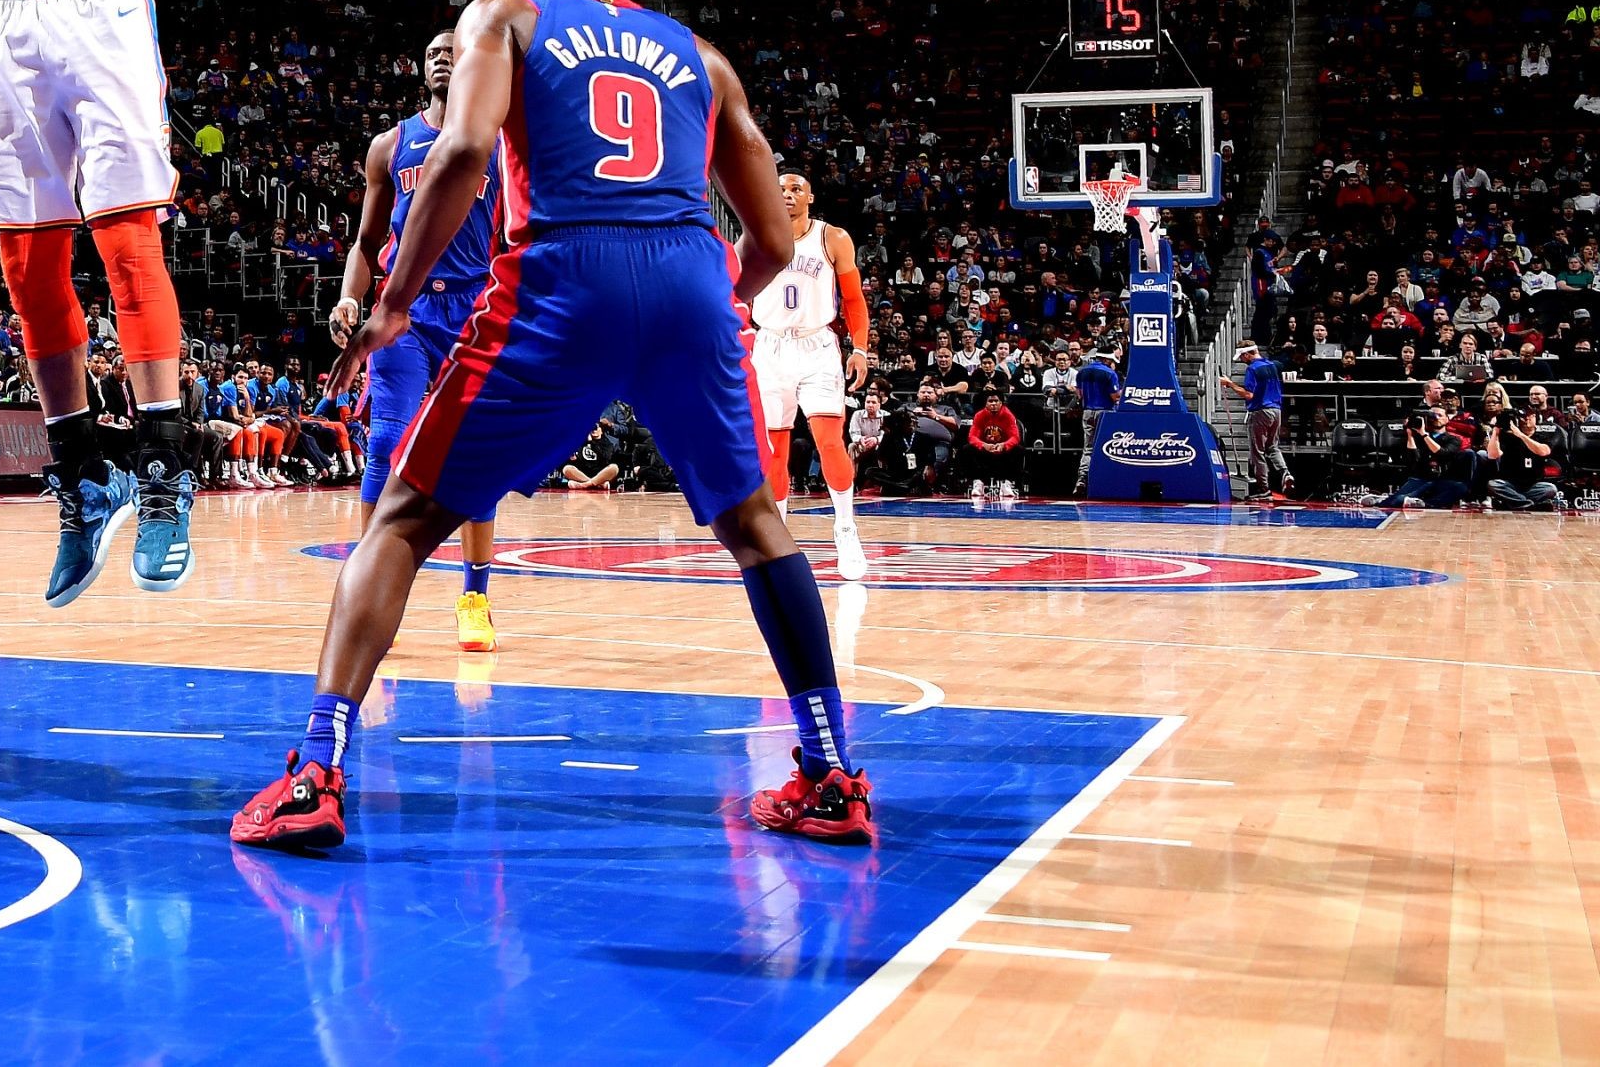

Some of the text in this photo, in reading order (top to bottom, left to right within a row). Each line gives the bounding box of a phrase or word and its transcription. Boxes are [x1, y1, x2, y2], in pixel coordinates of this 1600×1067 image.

[1097, 39, 1154, 51] TISSOT
[545, 25, 697, 90] GALLOWAY
[589, 70, 664, 183] 9
[784, 284, 799, 311] 0
[1141, 318, 1159, 328] Art
[1142, 327, 1161, 338] Van
[1125, 387, 1175, 398] Flagstar
[1112, 432, 1189, 448] Henry Ford
[1108, 447, 1192, 457] HEALTH SYSTEM
